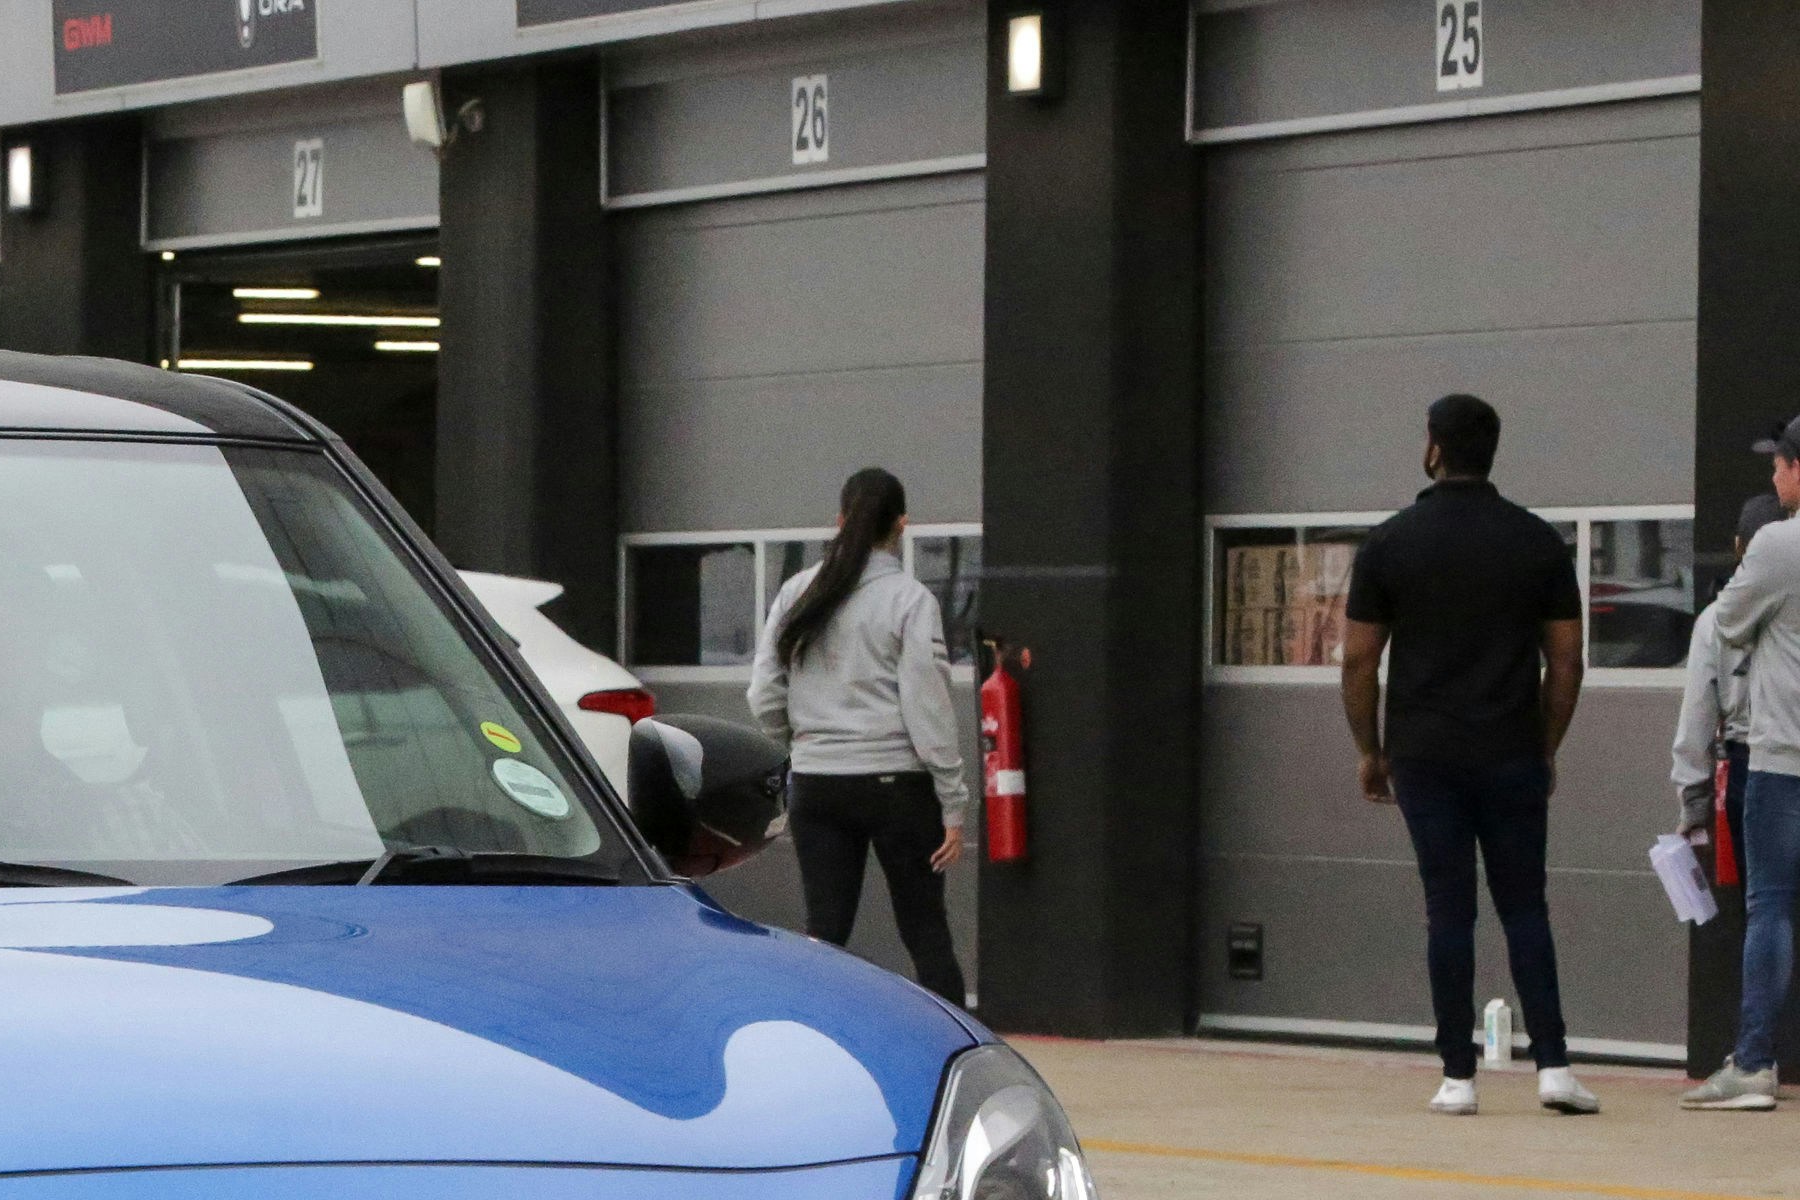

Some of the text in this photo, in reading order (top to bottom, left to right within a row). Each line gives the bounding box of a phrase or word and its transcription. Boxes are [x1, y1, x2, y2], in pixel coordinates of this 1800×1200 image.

[64, 14, 112, 50] GWM
[1440, 1, 1480, 77] 25
[796, 84, 825, 151] 26
[295, 148, 321, 207] 27
